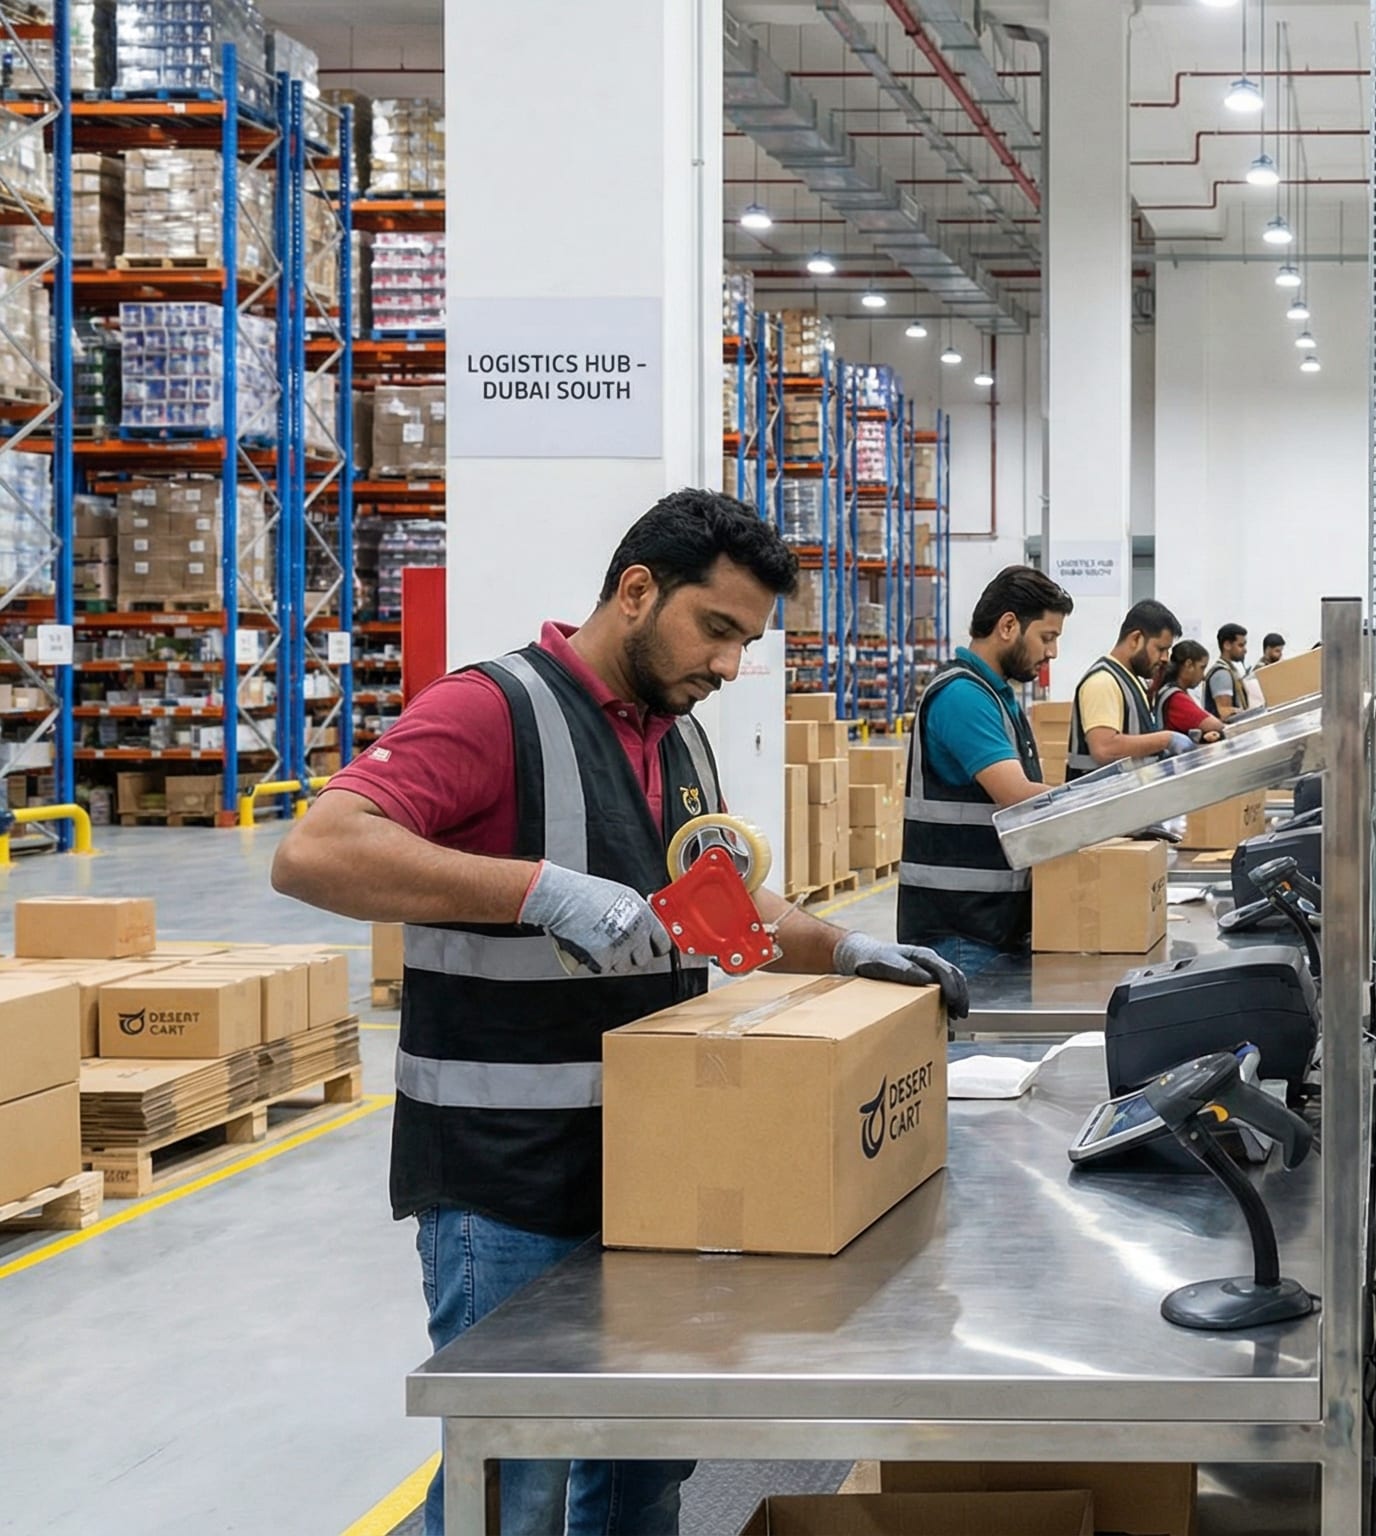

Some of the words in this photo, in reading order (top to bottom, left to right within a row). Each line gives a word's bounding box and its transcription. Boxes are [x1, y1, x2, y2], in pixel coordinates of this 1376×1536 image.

[467, 354, 578, 373] LOGISTICS
[585, 354, 631, 373] HUB
[483, 381, 550, 400] DUBAI
[556, 381, 631, 400] SOUTH
[889, 1060, 933, 1110] DESERT
[889, 1099, 922, 1141] CART
